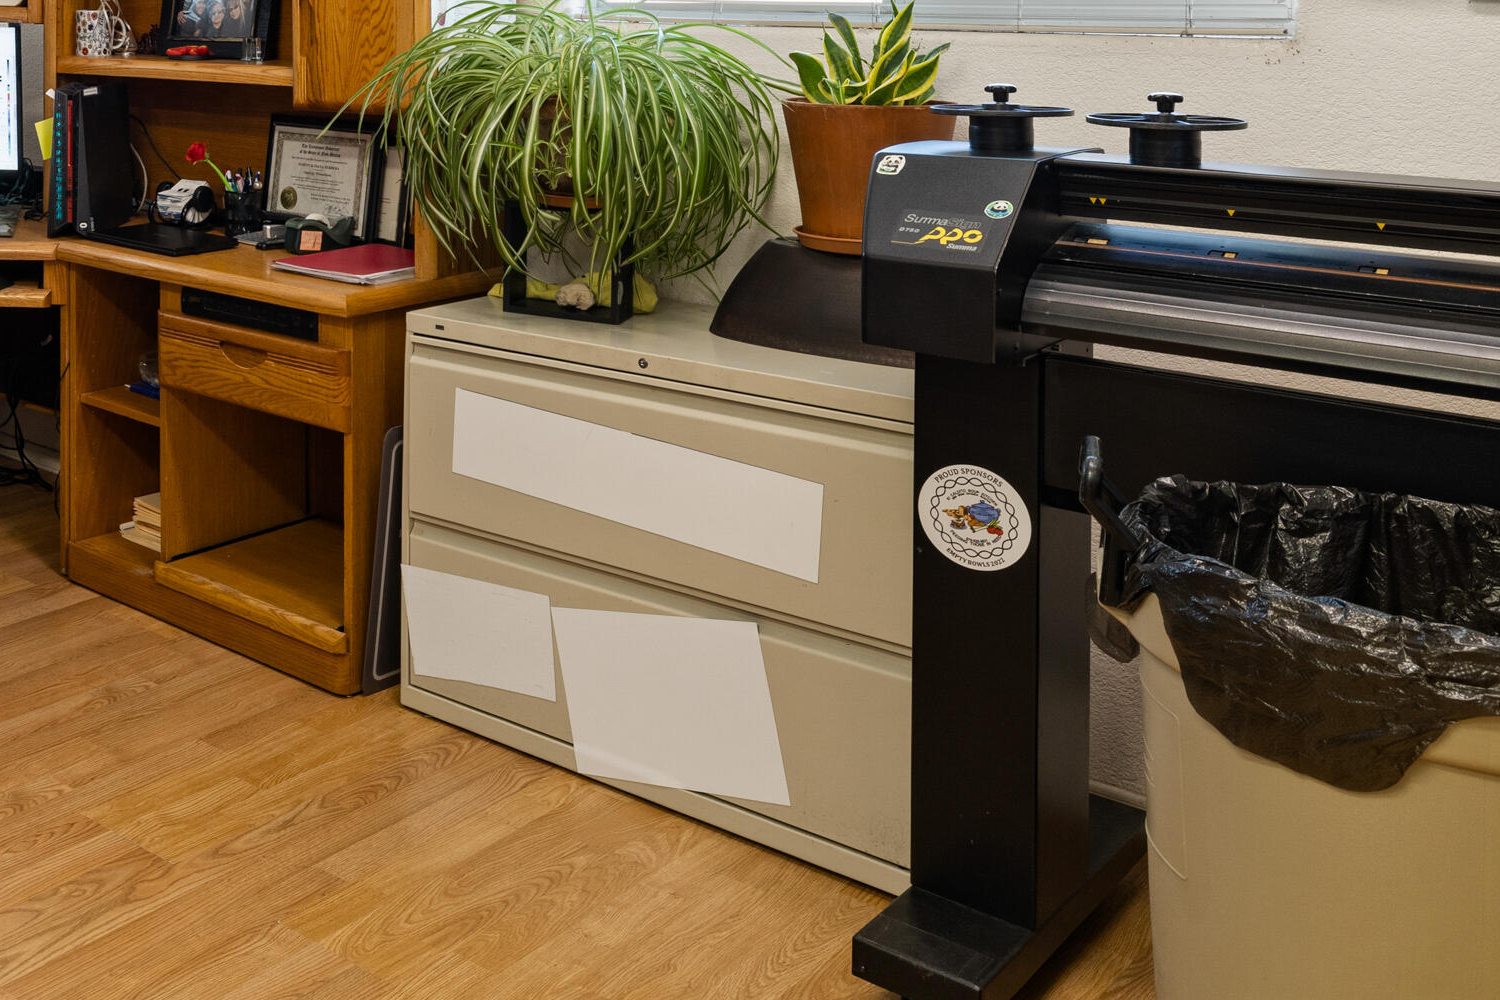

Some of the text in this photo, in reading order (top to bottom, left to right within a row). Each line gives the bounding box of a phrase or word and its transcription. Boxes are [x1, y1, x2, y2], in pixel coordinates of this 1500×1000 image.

[904, 213, 982, 230] SummaSign
[946, 243, 978, 252] Summa
[934, 468, 1003, 487] PROUD SPONSORS
[946, 547, 1006, 568] EMPTY BOWLS 2022
